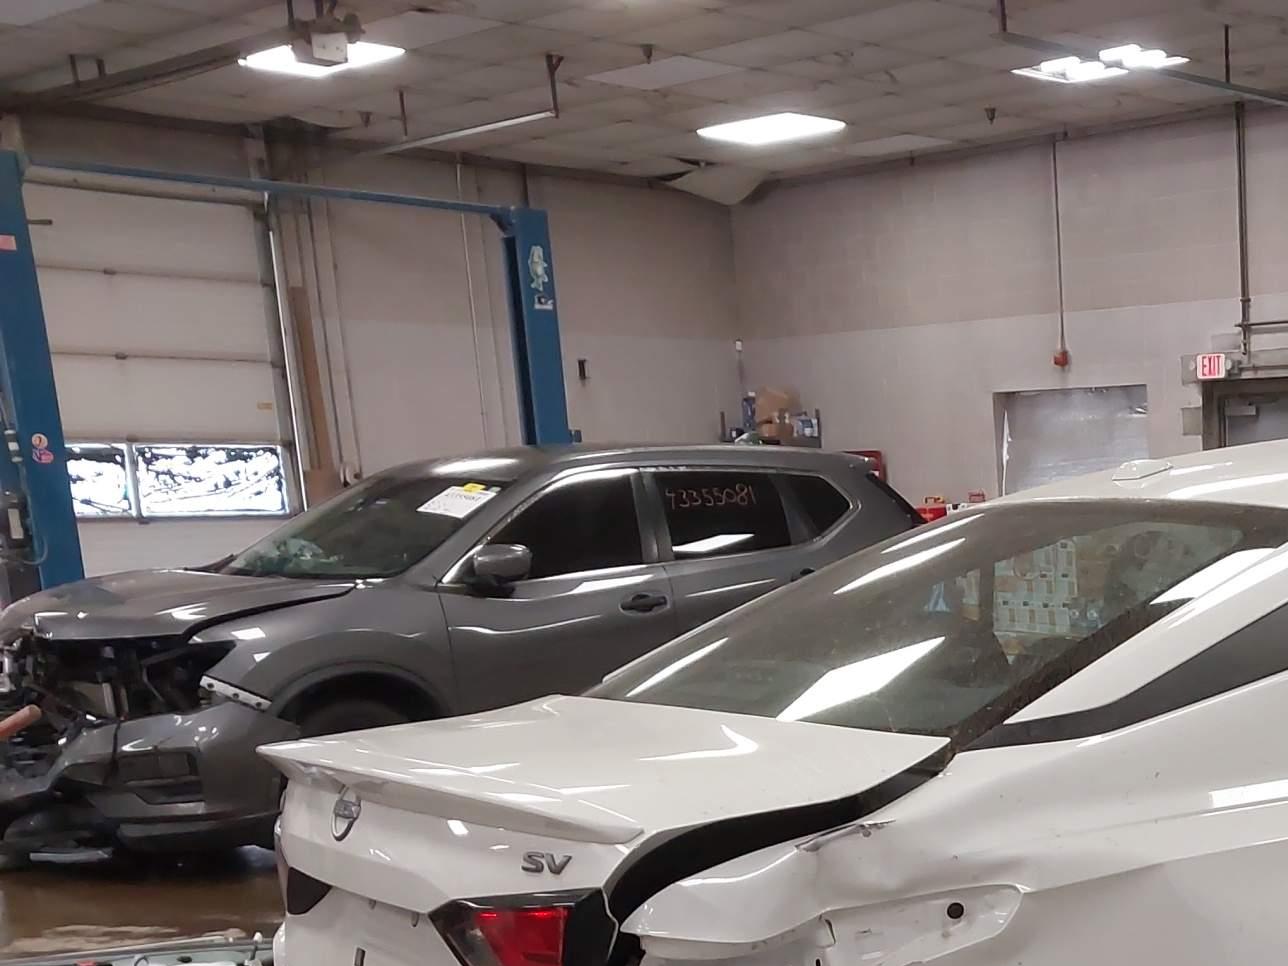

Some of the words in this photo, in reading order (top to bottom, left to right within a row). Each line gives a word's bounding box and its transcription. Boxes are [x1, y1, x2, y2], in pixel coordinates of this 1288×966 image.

[1201, 355, 1221, 377] EXIT
[665, 483, 757, 510] 43355081
[521, 851, 573, 875] SV
